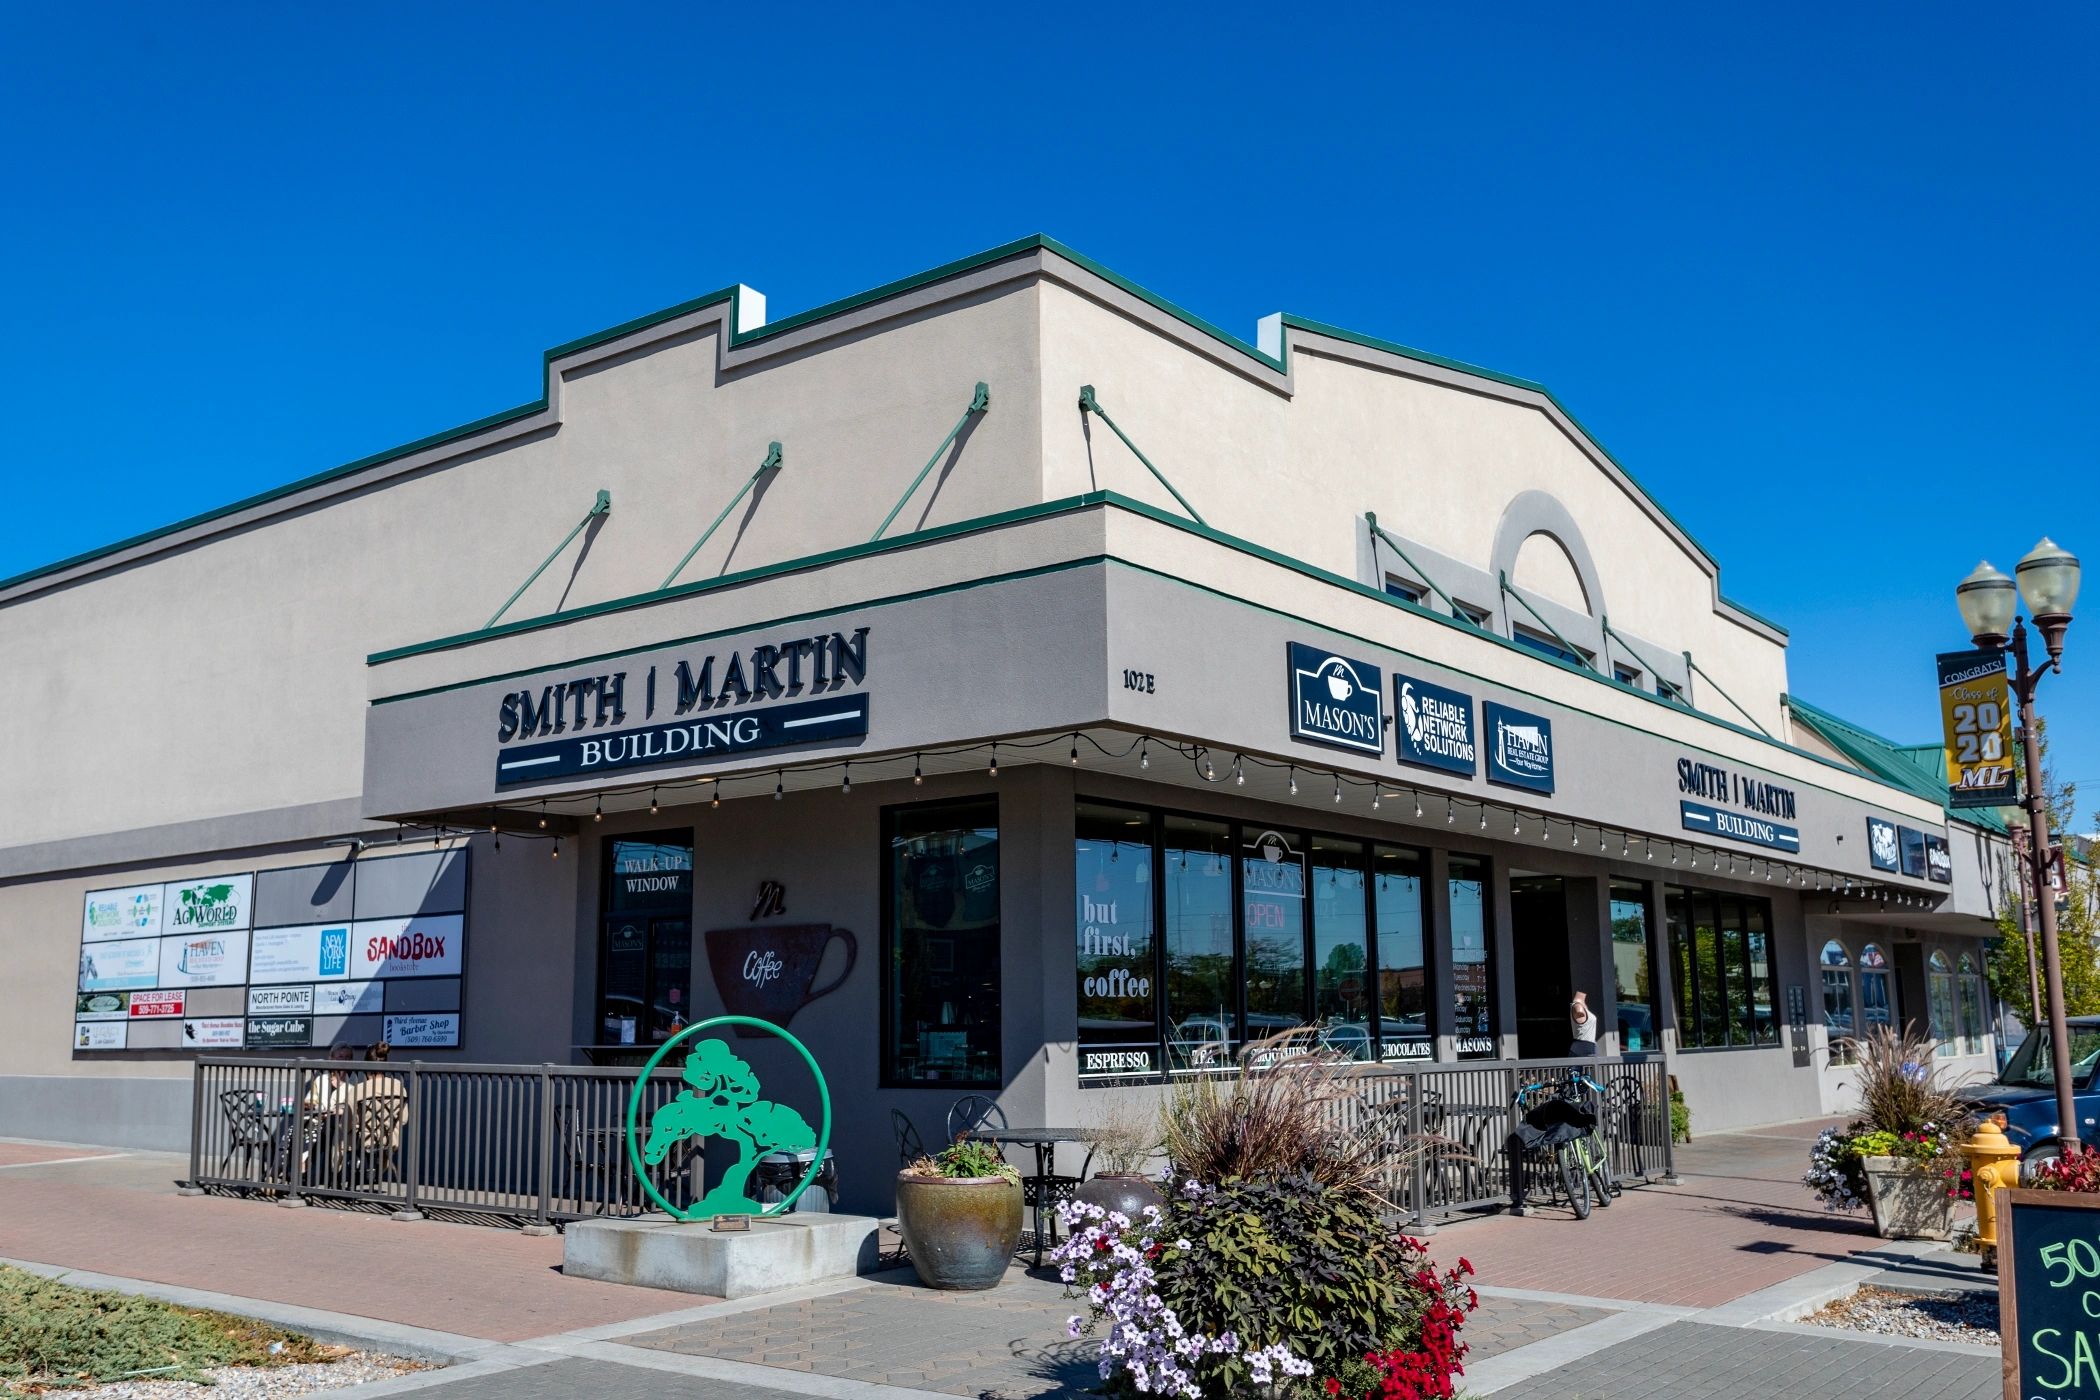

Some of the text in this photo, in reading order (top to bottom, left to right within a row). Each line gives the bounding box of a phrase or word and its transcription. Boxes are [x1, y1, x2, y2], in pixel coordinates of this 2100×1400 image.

[499, 671, 627, 738] SMITH
[676, 626, 872, 710] MARTIN
[1944, 660, 2002, 684] CONGRATS!
[1950, 686, 1999, 701] Class of
[1304, 700, 1375, 740] MASON'S
[1422, 696, 1465, 725] RELIABLE
[1953, 701, 2001, 734] 20
[580, 716, 760, 766] BUILDING
[1423, 715, 1467, 743] NETWORK
[1507, 728, 1548, 756] HAVEN
[1424, 732, 1474, 762] SOLUTIONS
[1518, 749, 1535, 761] ESTATE
[1956, 731, 2005, 764] 20
[1677, 757, 1729, 804] SMITH
[1741, 776, 1796, 820] MARTIN
[1956, 765, 2008, 791] ML
[1715, 812, 1774, 842] BUILDING
[624, 855, 682, 873] WALK-UP
[625, 876, 680, 893] WINDOW
[1245, 865, 1303, 891] MASON'S
[1082, 894, 1118, 924] but
[1248, 903, 1284, 928] OPEN
[321, 945, 345, 959] YORK
[325, 934, 344, 948] NEW
[1083, 926, 1136, 960] first,
[324, 956, 342, 970] LIFE
[743, 950, 783, 989] Coffee
[1083, 968, 1150, 998] coffee
[132, 991, 183, 1003] SPACE FOR LEASE
[252, 991, 310, 1005] NORTH POINTE
[248, 1020, 261, 1033] the
[261, 1021, 284, 1036] Sugar
[284, 1019, 305, 1033] Cube
[399, 1024, 428, 1036] Barber
[429, 1019, 450, 1030] Shop
[1381, 1042, 1431, 1058] CHOCOLATES
[1455, 1036, 1492, 1053] MASON'S
[1086, 1051, 1149, 1069] ESPRESSO
[2040, 1235, 2100, 1287] 50
[2032, 1328, 2100, 1391] SA
